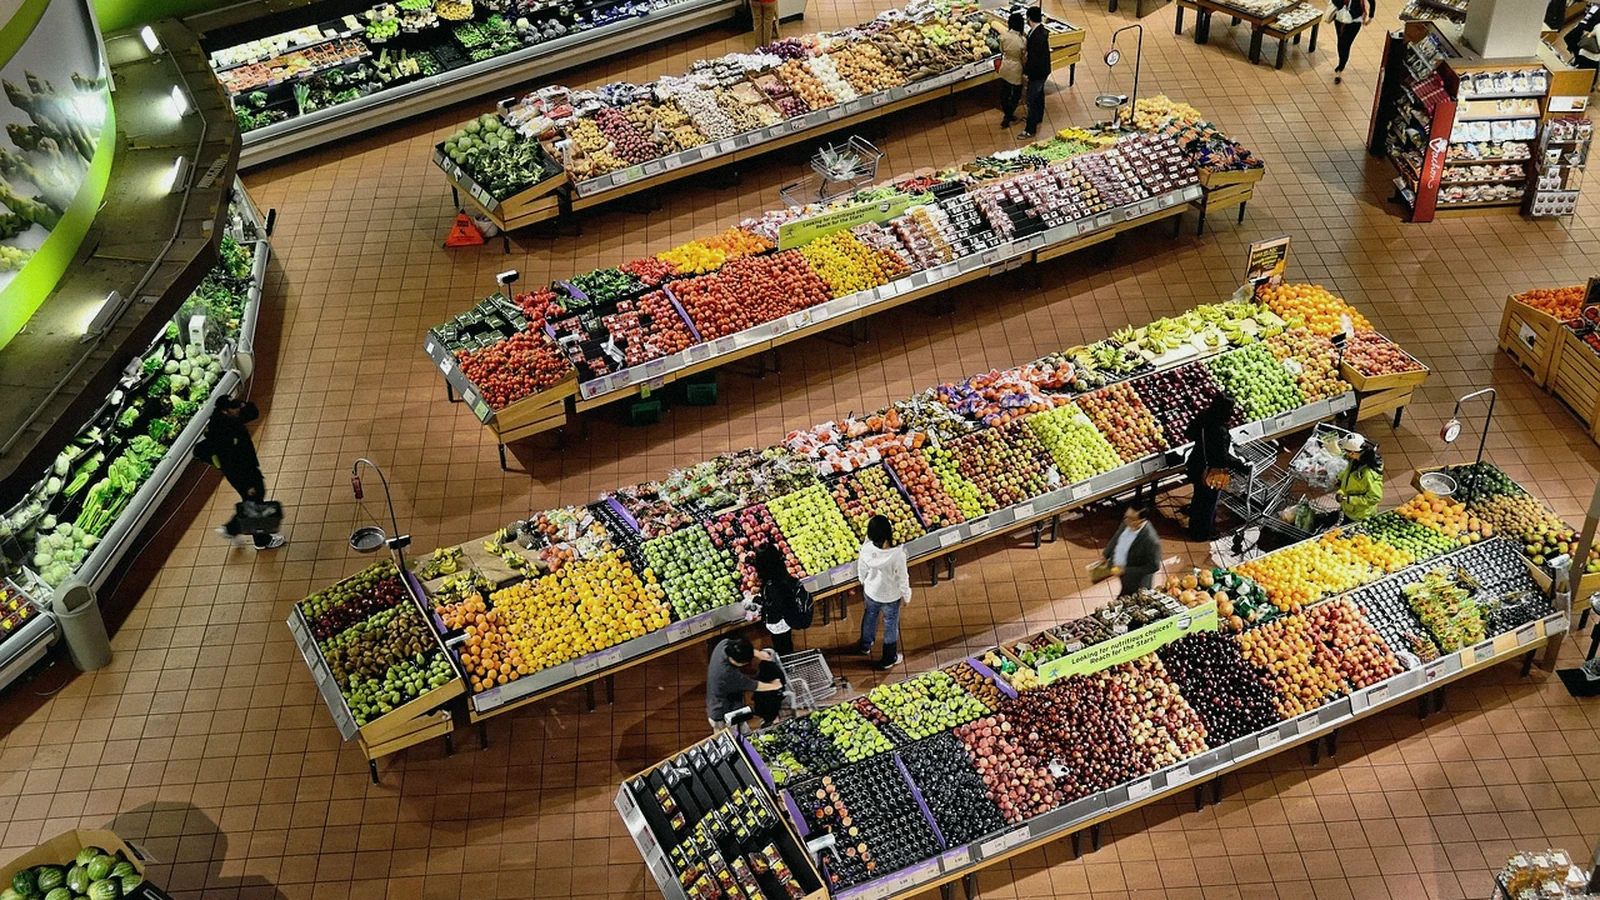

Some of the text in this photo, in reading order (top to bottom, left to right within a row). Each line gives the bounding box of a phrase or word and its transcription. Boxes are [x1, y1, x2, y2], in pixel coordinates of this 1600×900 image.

[803, 219, 822, 228] Looking
[832, 210, 855, 220] nutritious
[857, 205, 877, 214] choices?
[1071, 621, 1173, 665] Looking for nutritious choices?
[1090, 634, 1157, 664] Reach for the Stars!
